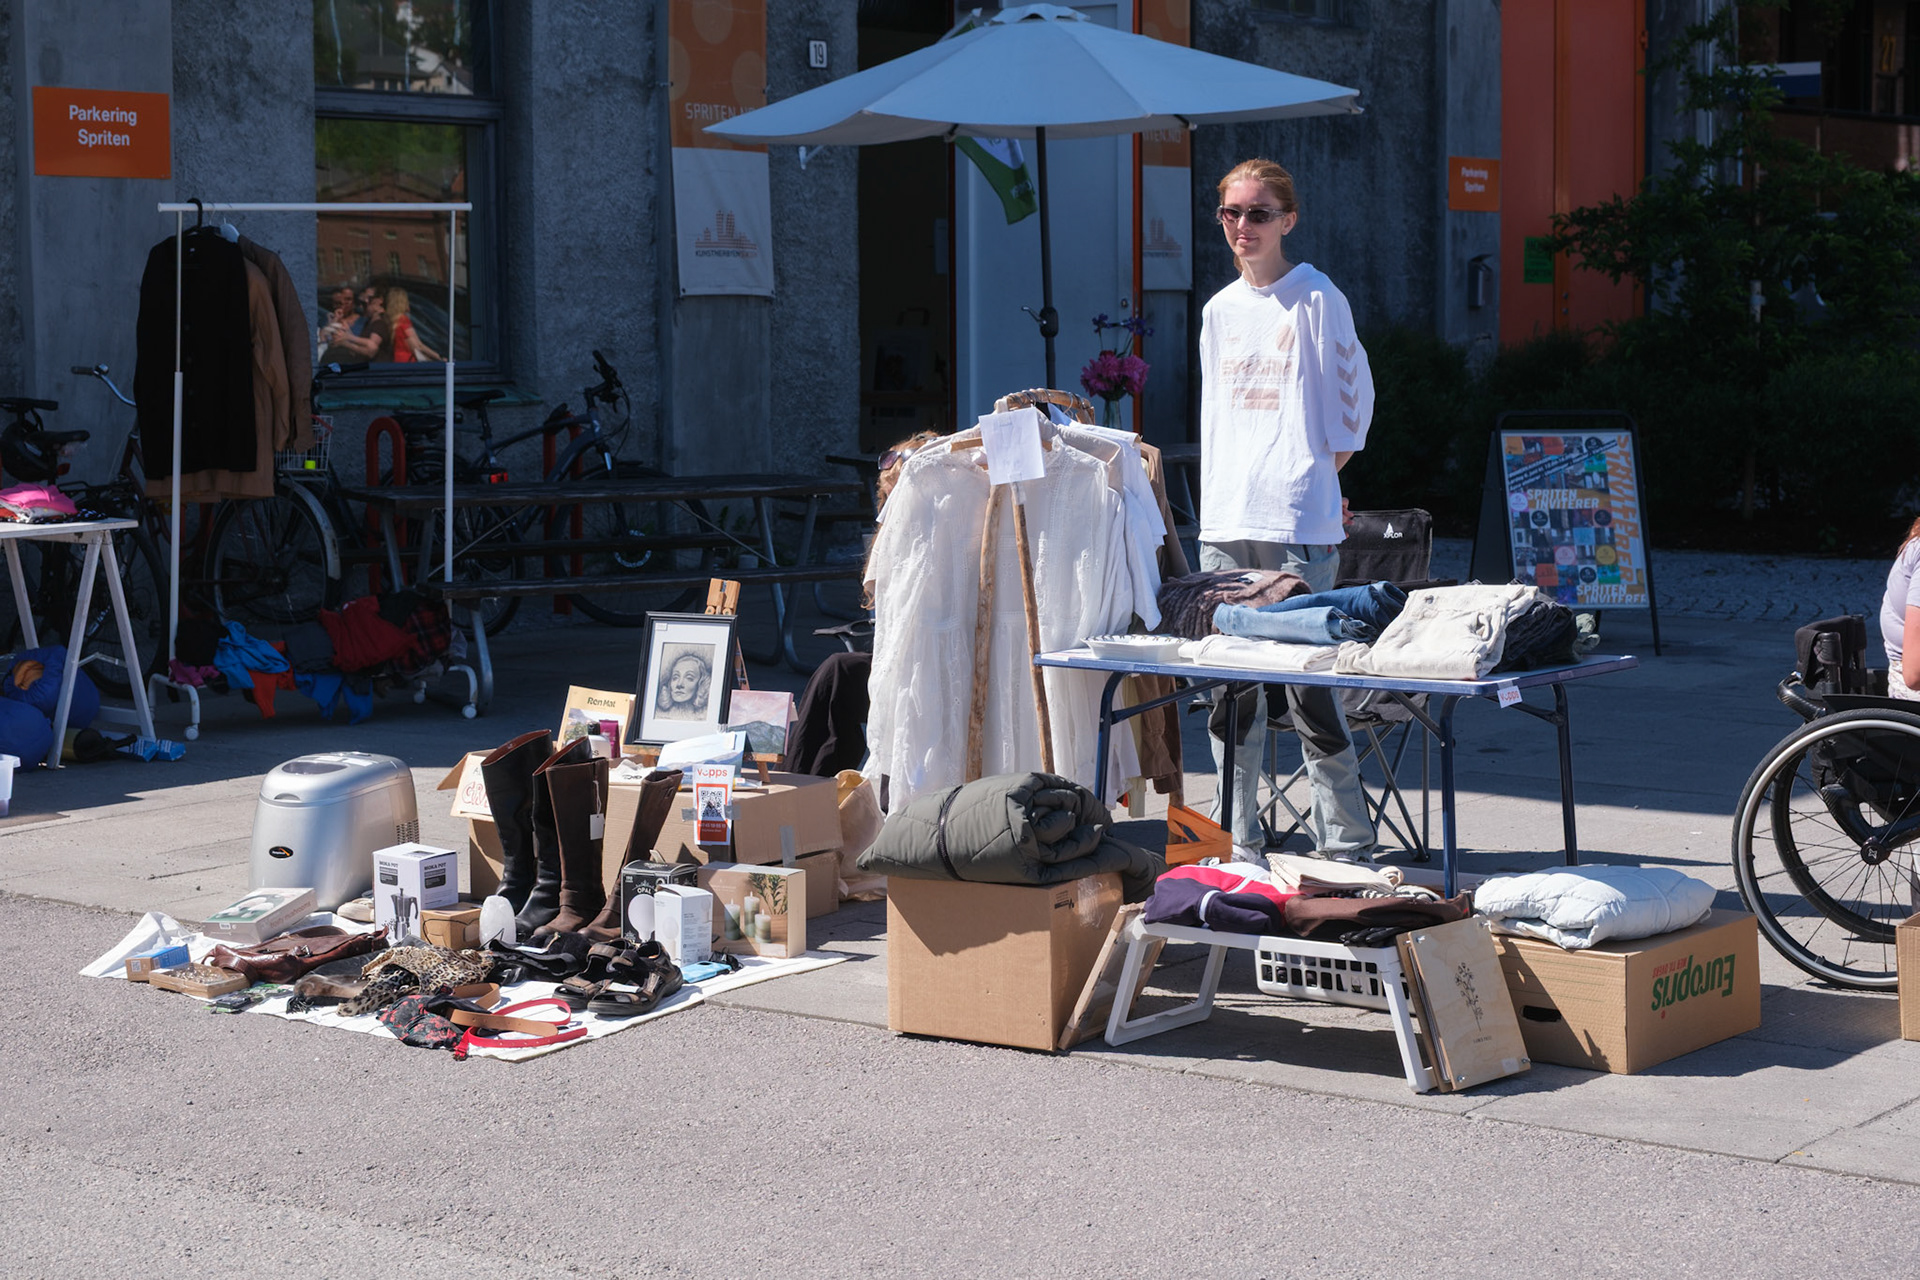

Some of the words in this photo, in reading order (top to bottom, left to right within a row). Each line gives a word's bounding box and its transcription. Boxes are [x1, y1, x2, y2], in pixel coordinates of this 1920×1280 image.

[812, 44, 824, 65] 19
[68, 104, 138, 126] Parkering
[684, 102, 756, 120] SPRITEN
[77, 129, 131, 147] Spriten
[1527, 489, 1577, 501] SPRITEN
[1535, 498, 1599, 509] INVITERER
[1576, 584, 1628, 596] SPRITEN
[636, 886, 652, 895] OPAL
[1651, 953, 1736, 1019] Europris
